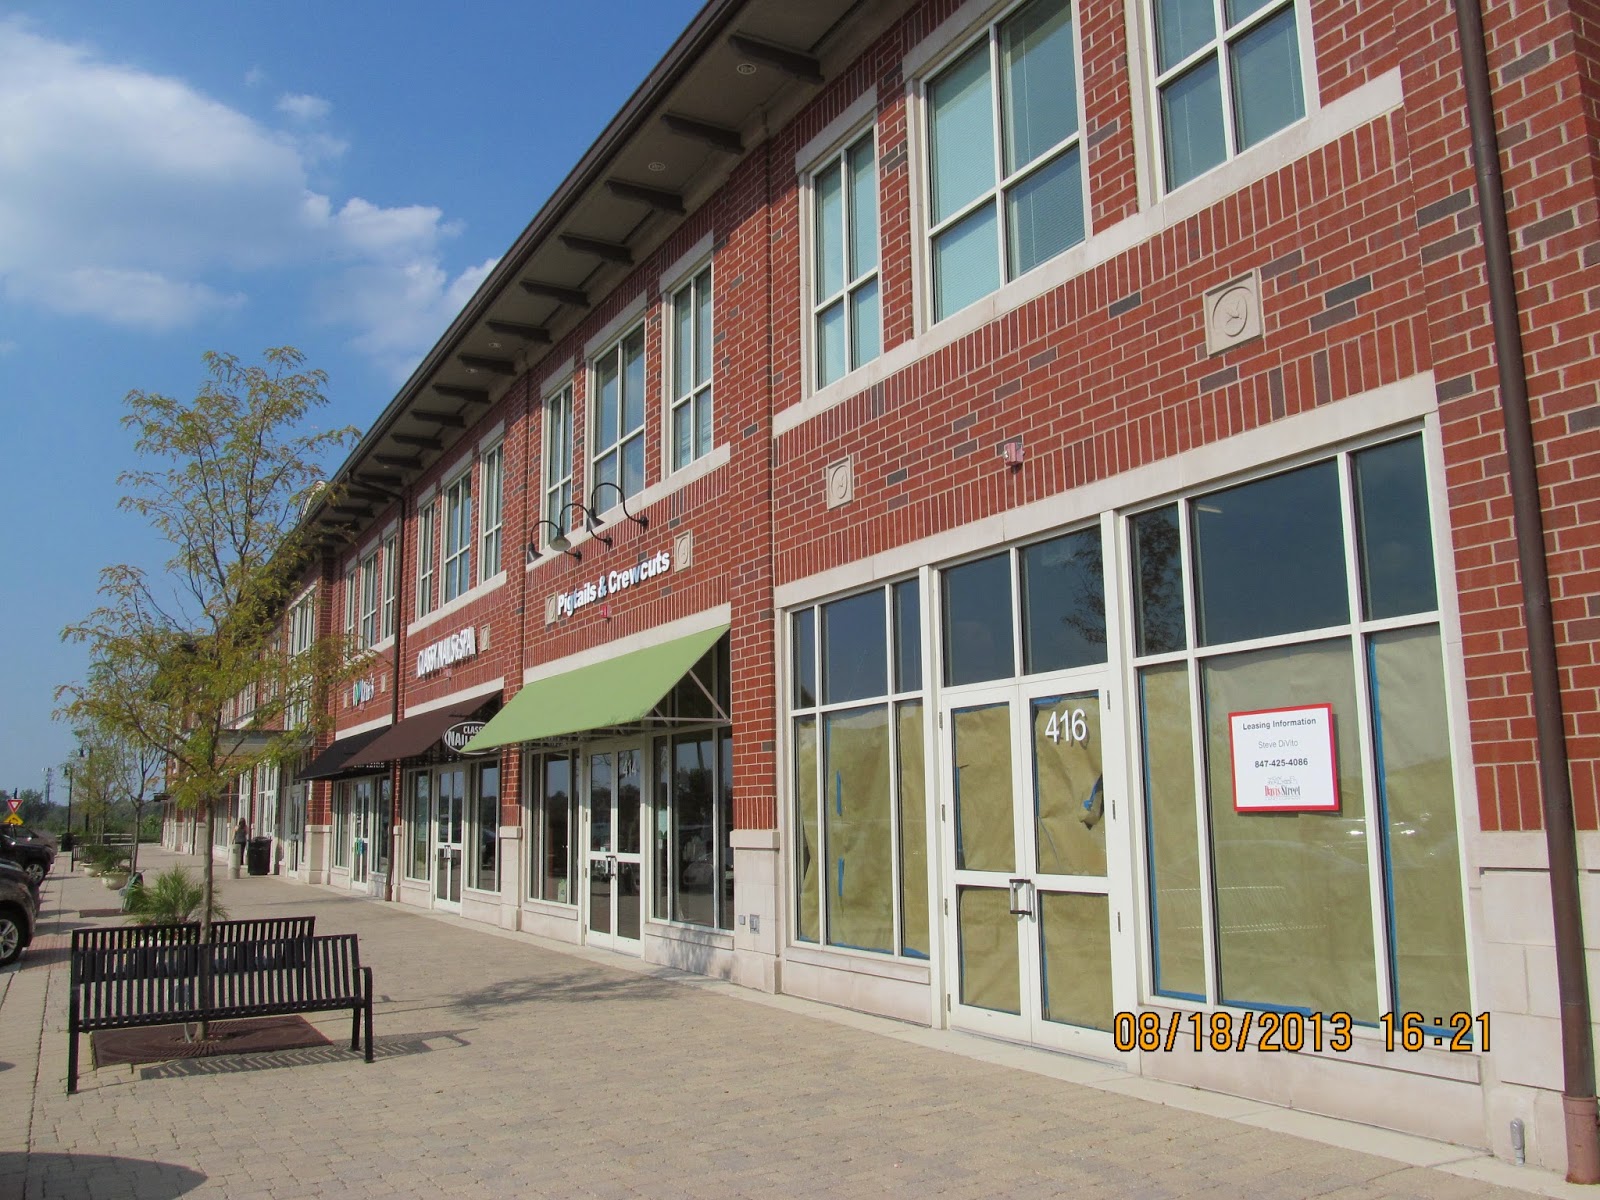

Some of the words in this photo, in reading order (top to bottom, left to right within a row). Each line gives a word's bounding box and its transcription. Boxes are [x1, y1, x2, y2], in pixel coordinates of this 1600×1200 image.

[557, 582, 597, 617] Pigtails
[598, 575, 608, 598] &
[608, 550, 671, 594] Crewcuts
[463, 725, 483, 734] CLASS
[1045, 708, 1087, 743] 416
[1242, 721, 1271, 730] Leasing
[1273, 718, 1317, 728] Information
[1258, 740, 1277, 749] Steve
[1278, 739, 1299, 748] DiVito
[622, 759, 638, 778] 414
[1254, 757, 1309, 768] 847-425-4086
[1264, 785, 1281, 797] Davis
[1280, 784, 1301, 796] Street
